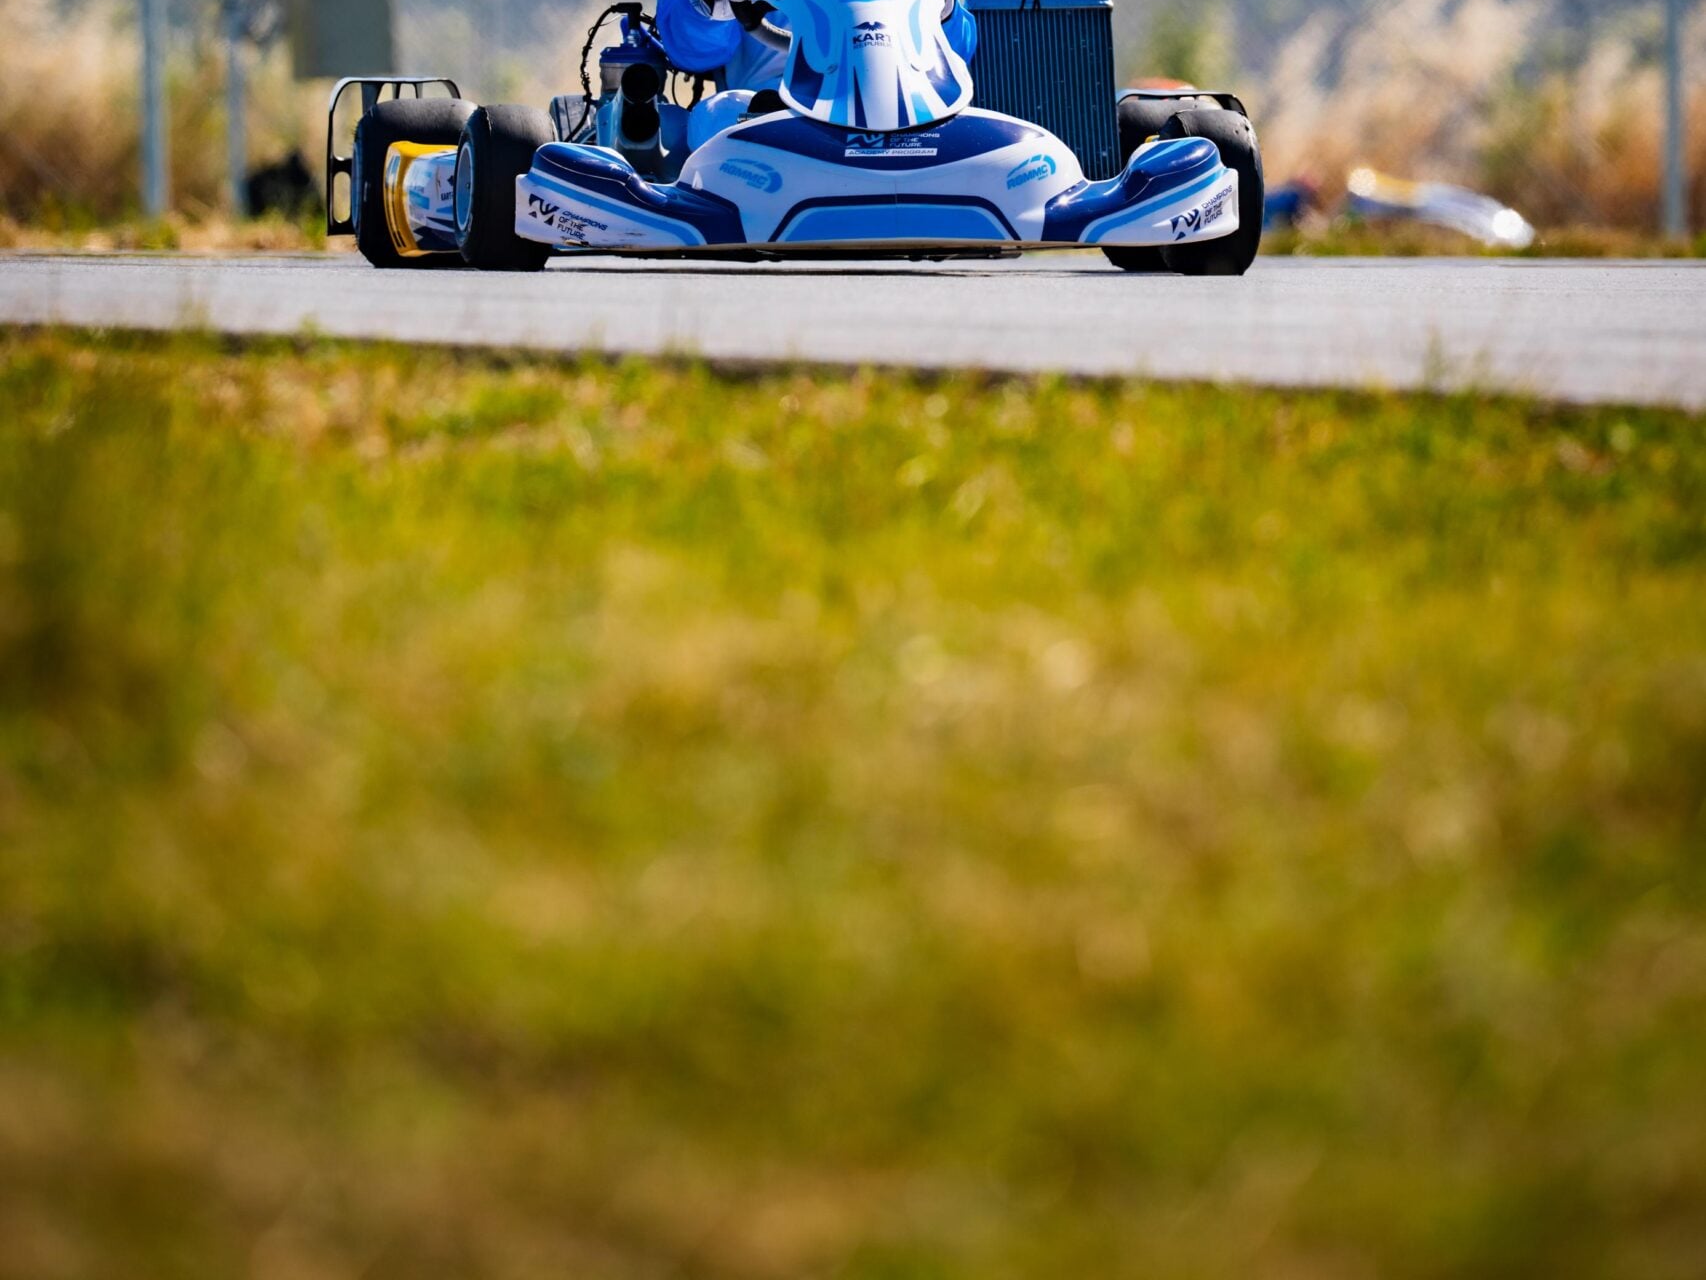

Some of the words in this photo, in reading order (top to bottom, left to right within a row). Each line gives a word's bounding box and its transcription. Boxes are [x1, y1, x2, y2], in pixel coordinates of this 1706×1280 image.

[852, 32, 892, 45] KART
[558, 216, 570, 224] OF
[570, 220, 585, 232] THE
[562, 210, 609, 231] CHAMPIONS
[557, 223, 586, 240] FUTURE
